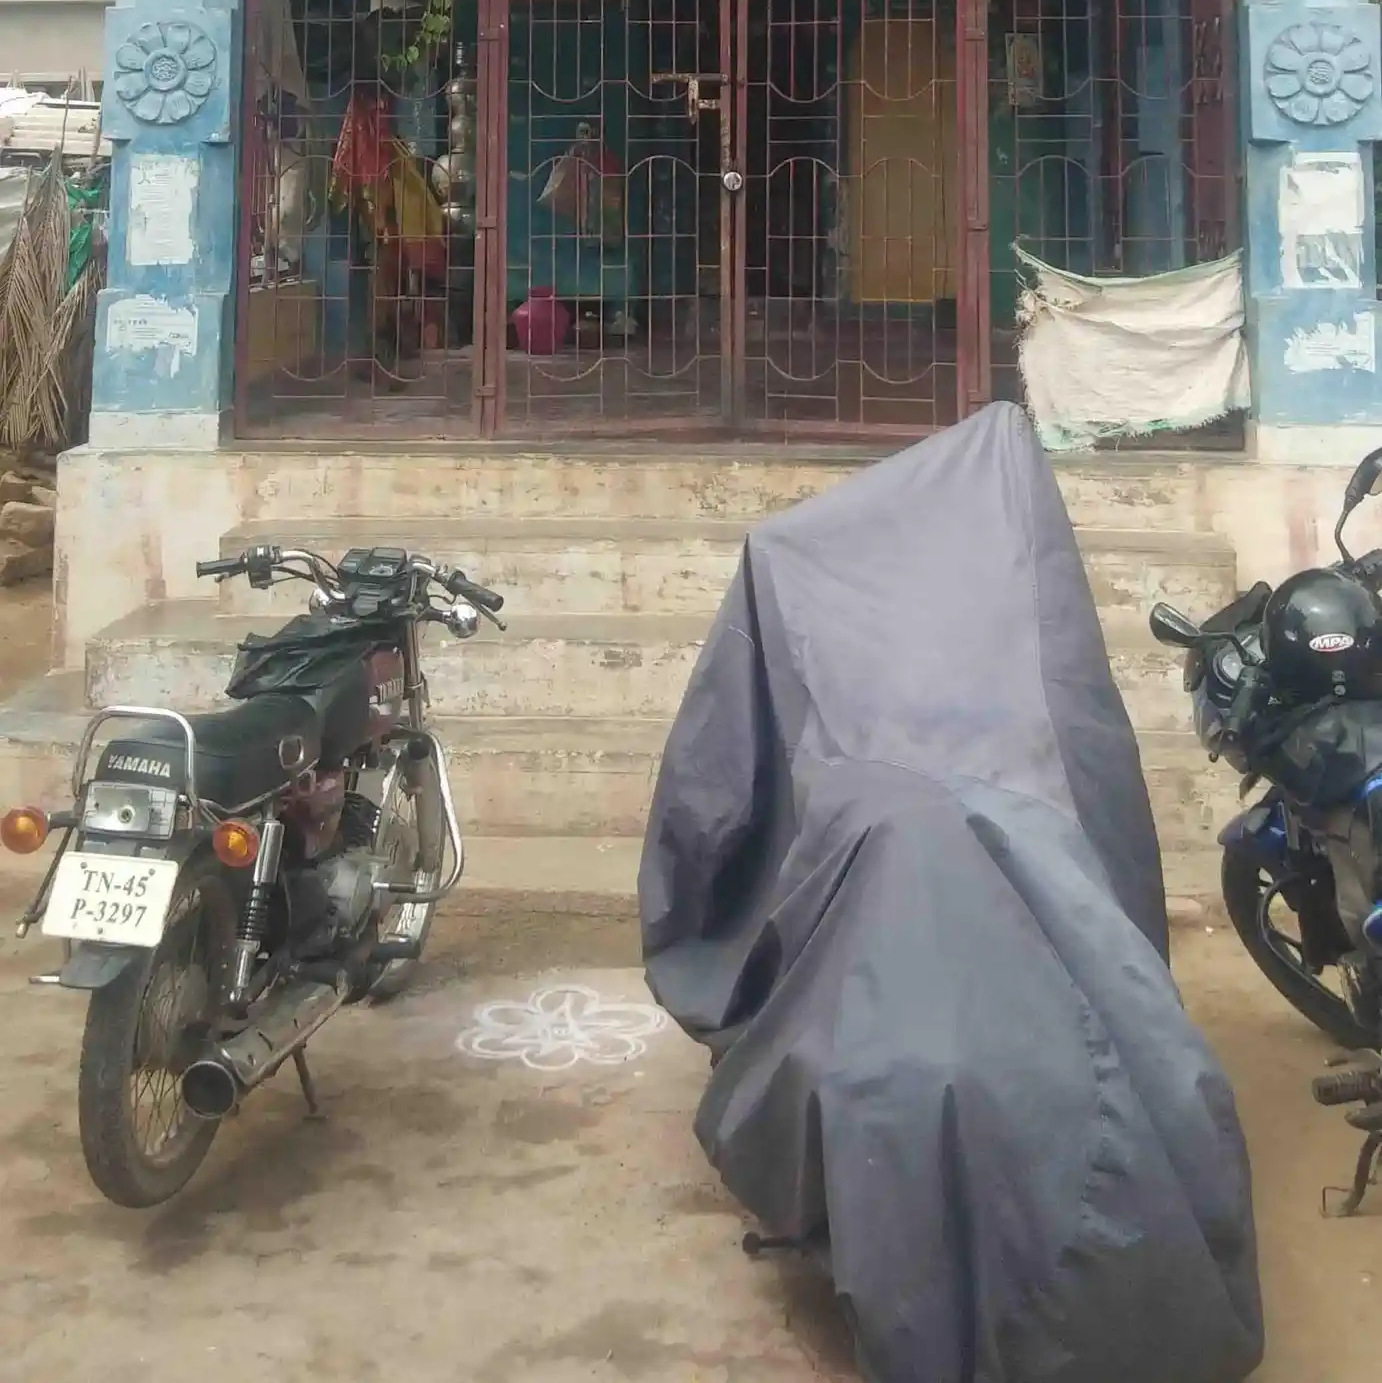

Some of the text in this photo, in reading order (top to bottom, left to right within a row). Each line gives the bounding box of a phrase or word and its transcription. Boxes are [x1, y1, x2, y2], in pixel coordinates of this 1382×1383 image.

[107, 754, 171, 778] YAMAHA
[82, 869, 149, 898] TN-45
[70, 898, 148, 928] P-3297
